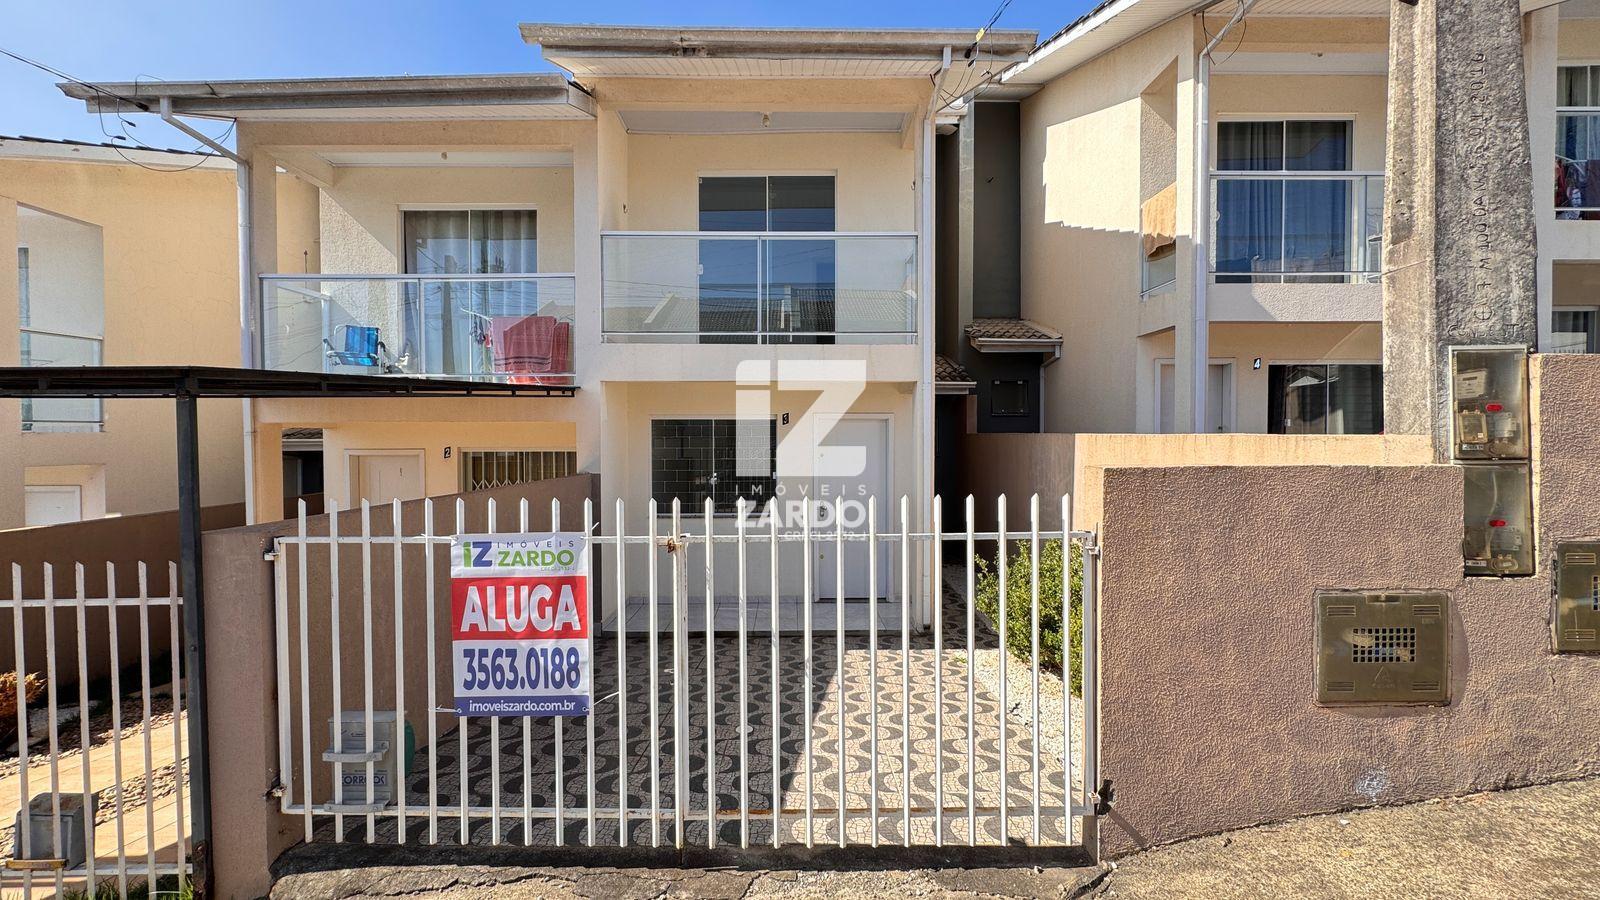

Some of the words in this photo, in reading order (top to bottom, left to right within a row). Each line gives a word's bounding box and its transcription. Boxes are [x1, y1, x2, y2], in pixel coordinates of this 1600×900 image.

[497, 540, 574, 548] IMÓVEIS
[498, 550, 574, 567] ZARDO
[460, 584, 581, 632] ALUGA
[463, 647, 580, 691] 3563.0188
[469, 700, 575, 712] imoveiszardo.com.br
